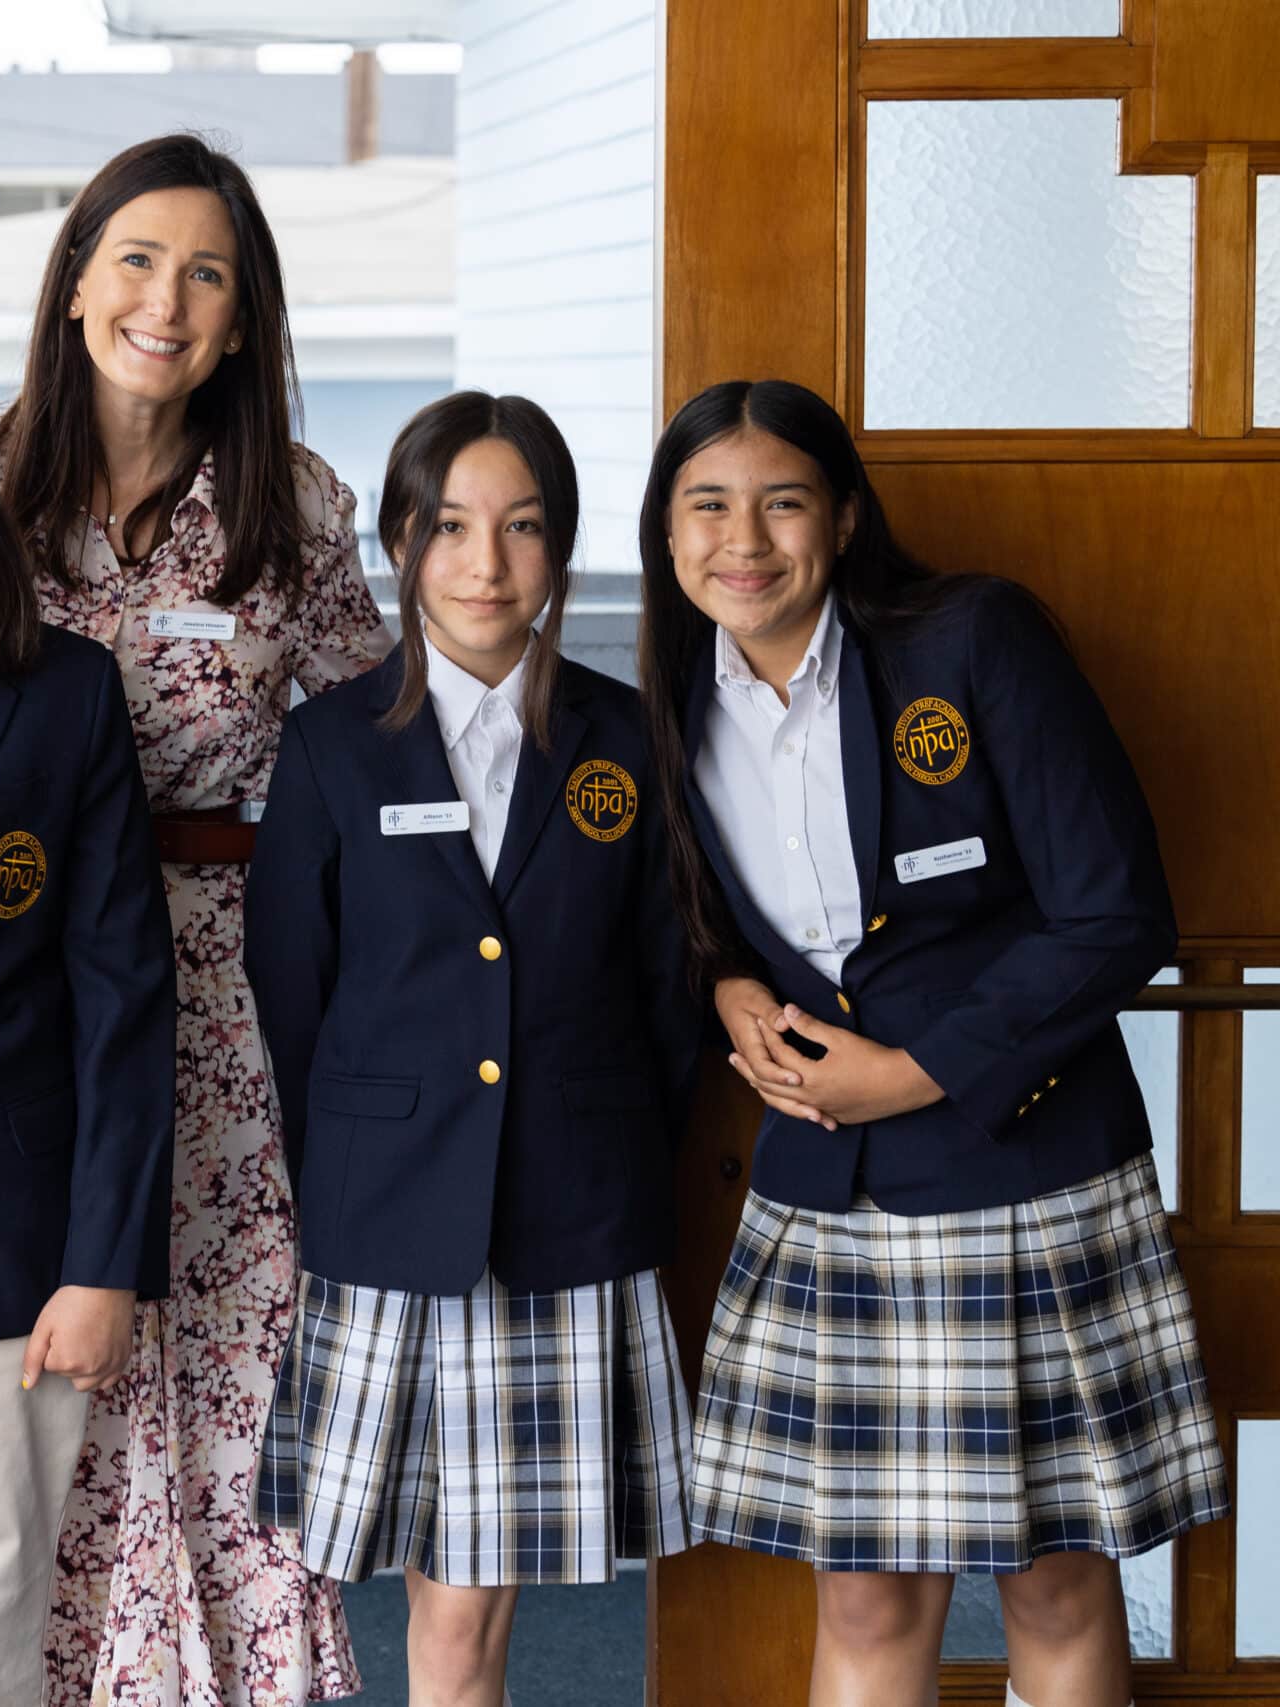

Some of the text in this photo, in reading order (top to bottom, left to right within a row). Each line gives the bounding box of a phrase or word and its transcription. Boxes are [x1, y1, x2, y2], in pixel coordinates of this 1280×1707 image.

[895, 699, 964, 741] NATIVITY PREP ACADEMY
[926, 714, 944, 725] 2001
